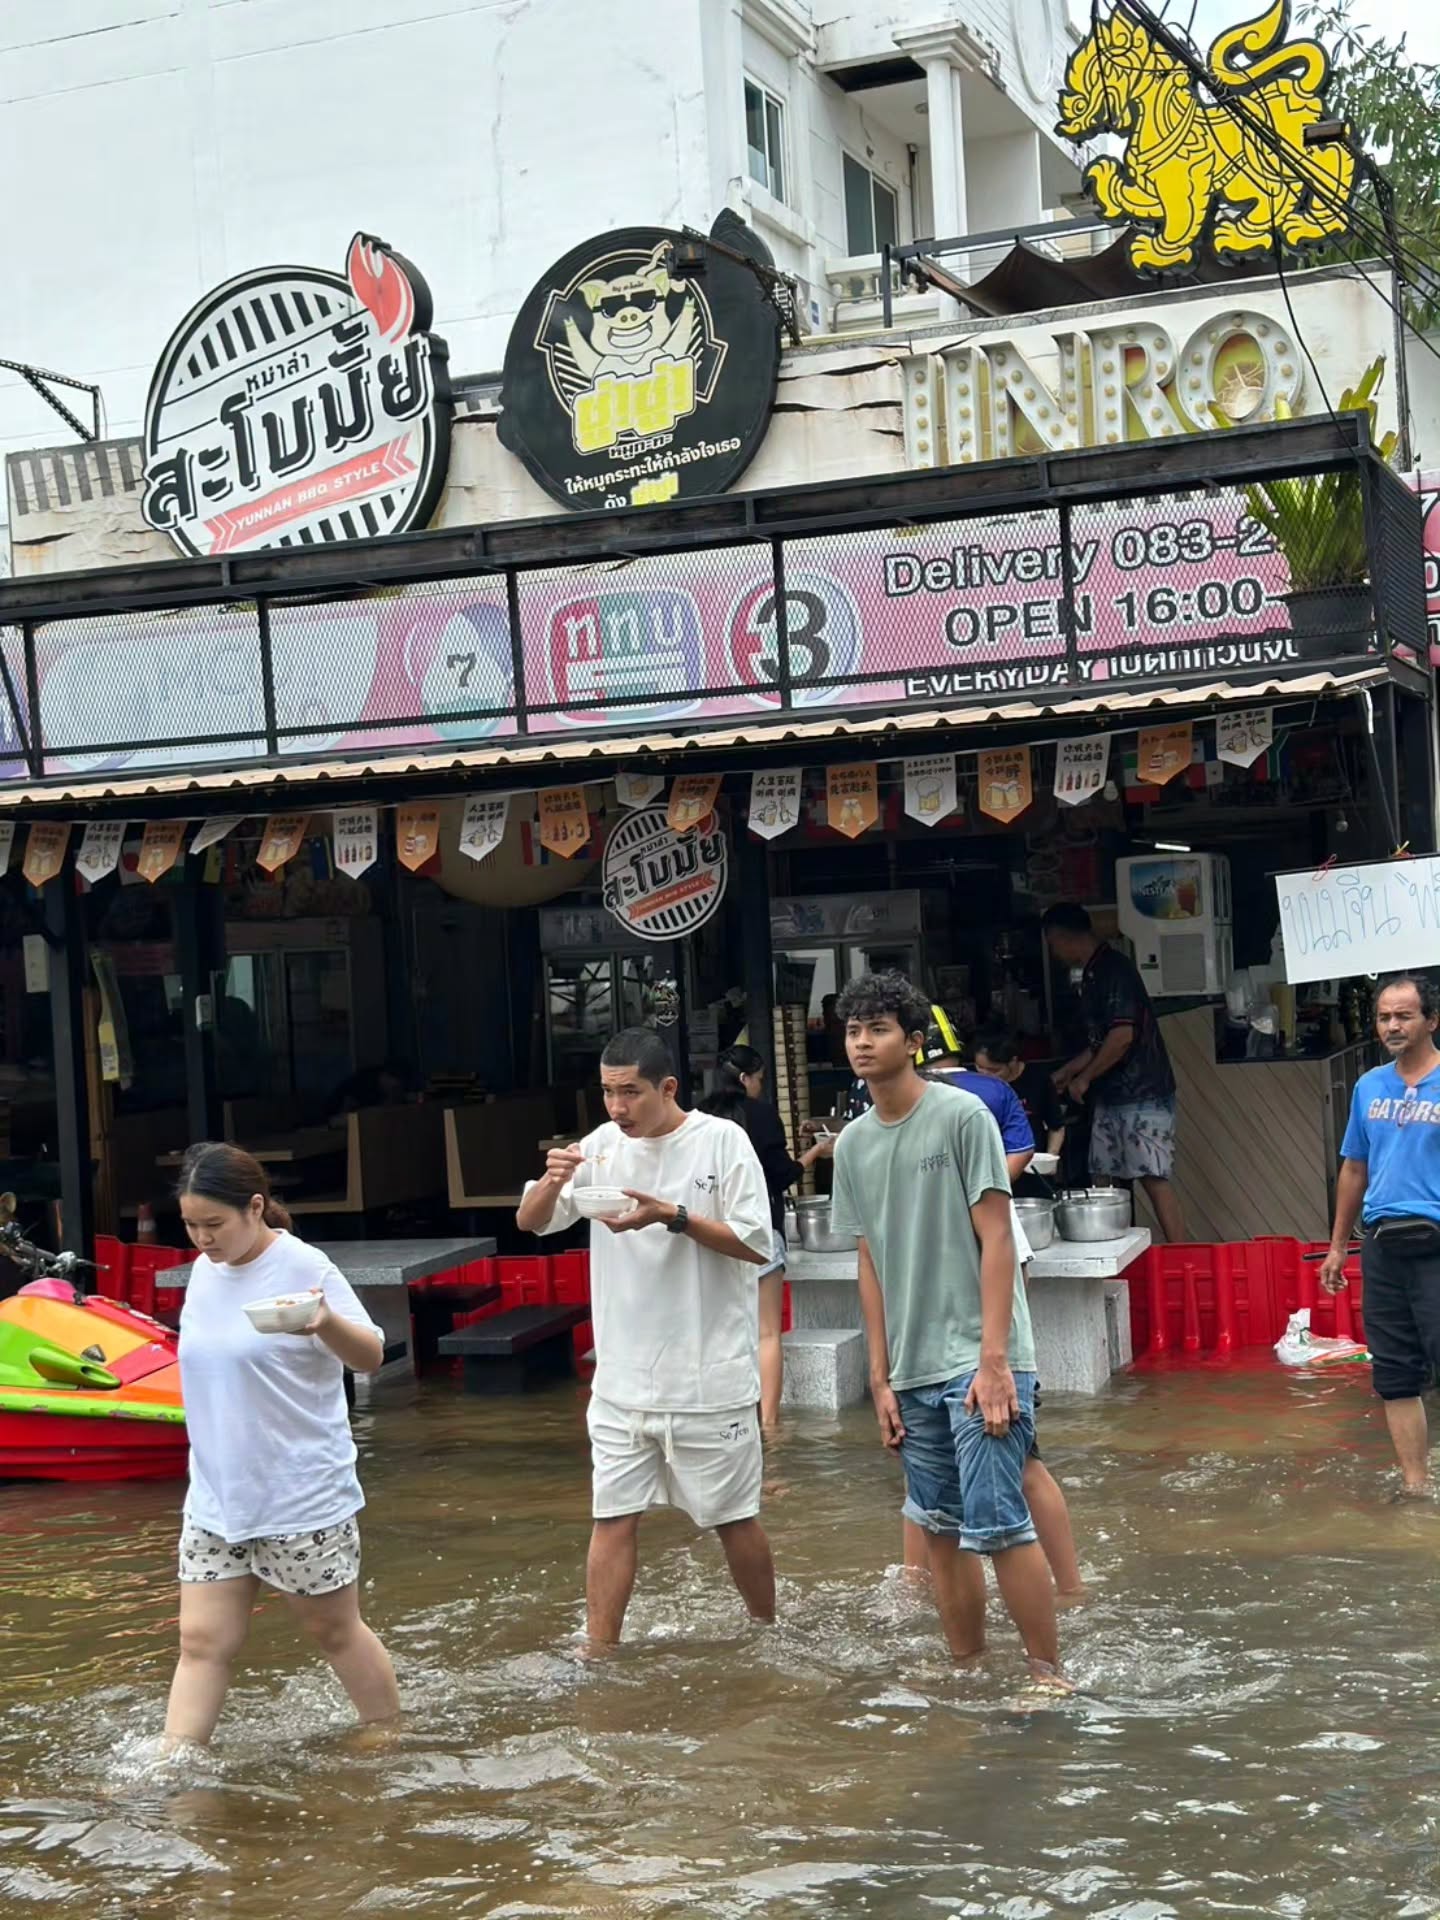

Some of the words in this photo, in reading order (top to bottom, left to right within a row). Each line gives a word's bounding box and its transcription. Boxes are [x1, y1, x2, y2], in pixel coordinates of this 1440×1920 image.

[246, 351, 309, 393] หม่าล่า
[148, 321, 428, 527] สะโบมั้ย
[564, 437, 741, 494] ให้หมูกระทะให้กำลังใจเธอ
[236, 495, 292, 531] YUNNAN
[296, 484, 328, 503] BBQ
[333, 462, 381, 489] STYLE
[884, 540, 1098, 597] Delivery
[757, 590, 829, 687] 3
[945, 595, 1093, 647] OPEN
